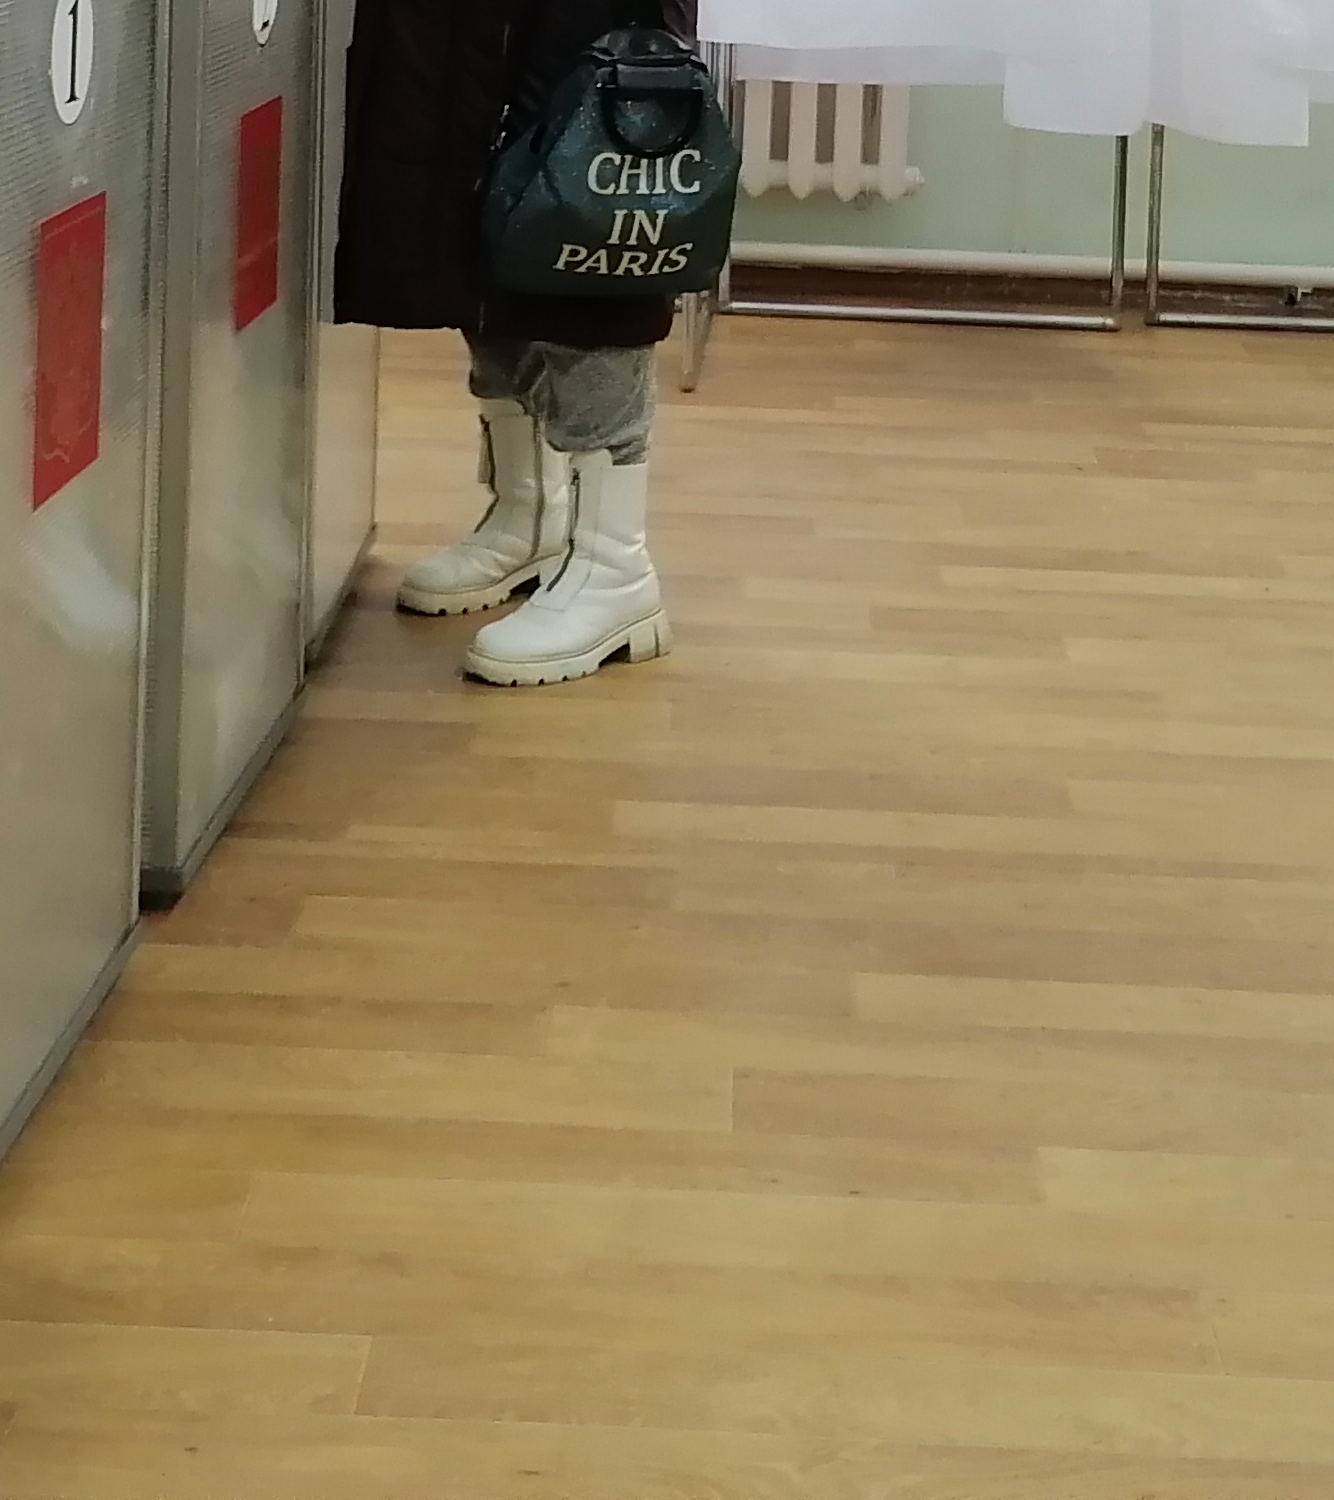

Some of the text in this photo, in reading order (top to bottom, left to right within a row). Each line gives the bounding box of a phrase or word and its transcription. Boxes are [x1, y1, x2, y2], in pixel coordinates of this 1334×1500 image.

[587, 149, 701, 195] CHIC
[606, 208, 669, 246] IN
[552, 242, 695, 277] PARIS
